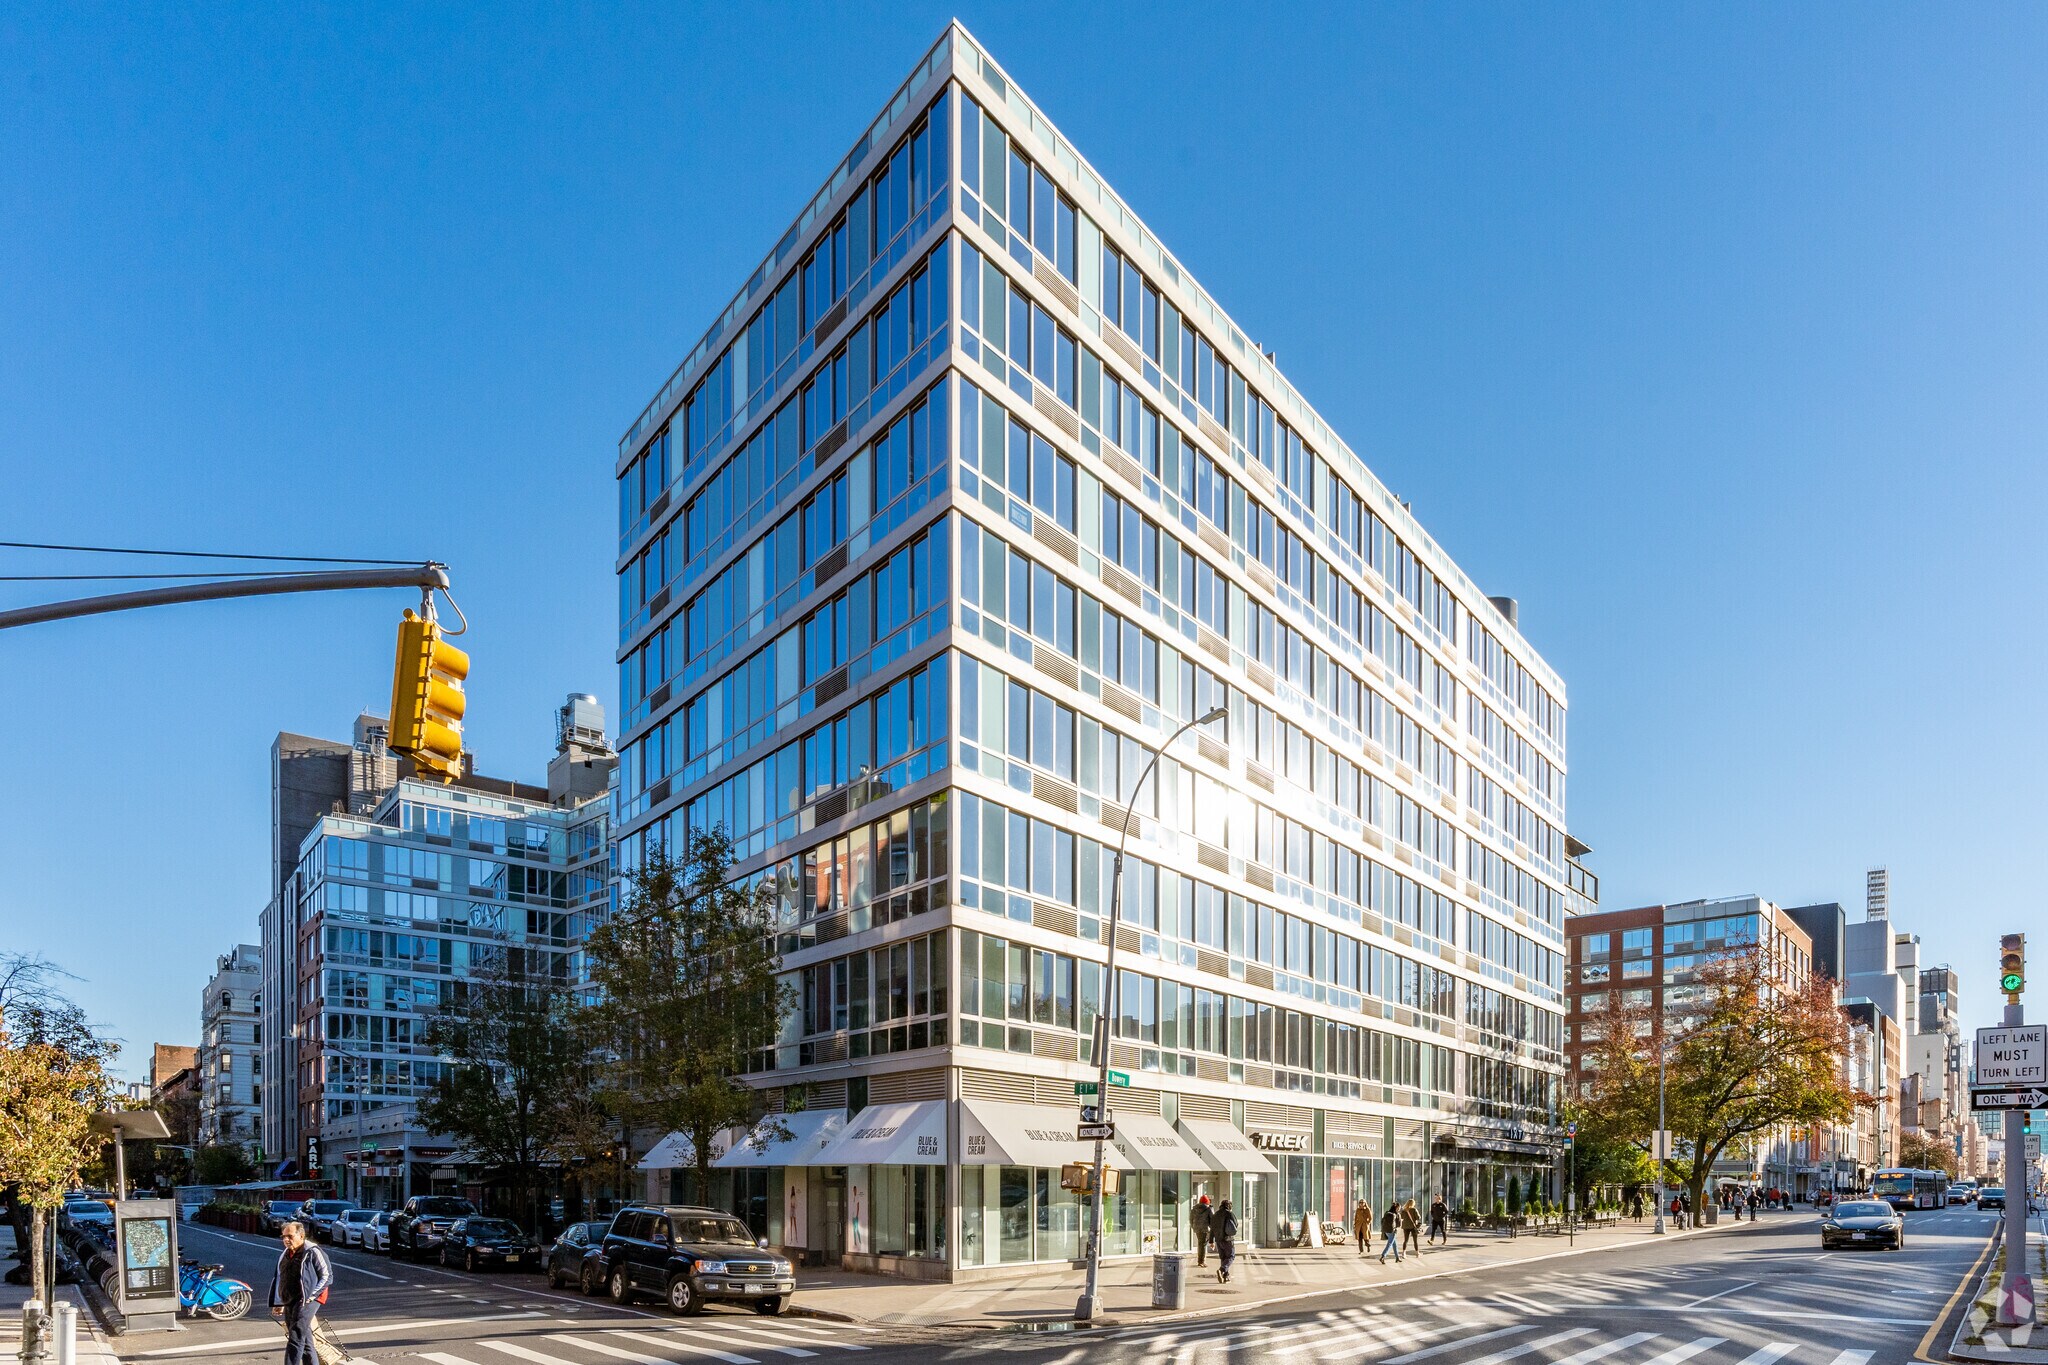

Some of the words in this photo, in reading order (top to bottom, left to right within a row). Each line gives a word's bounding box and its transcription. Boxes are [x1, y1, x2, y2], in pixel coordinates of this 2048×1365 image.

[1983, 1035, 2007, 1045] LEFT
[2013, 1033, 2040, 1043] LANE
[1994, 1050, 2029, 1062] MUST
[1982, 1068, 2010, 1078] TURN
[2015, 1067, 2041, 1077] LEFT
[1983, 1095, 2007, 1104] ONE
[2018, 1094, 2043, 1104] WAY
[918, 1135, 932, 1146] BLUE
[932, 1135, 938, 1146] &
[968, 1135, 981, 1145] BLUE
[981, 1135, 986, 1145] &
[1024, 1129, 1045, 1141] BLUE
[1049, 1130, 1077, 1142] CREAM
[1256, 1132, 1310, 1150] TREK
[917, 1145, 938, 1156] CREAM
[967, 1145, 986, 1155] CREAM
